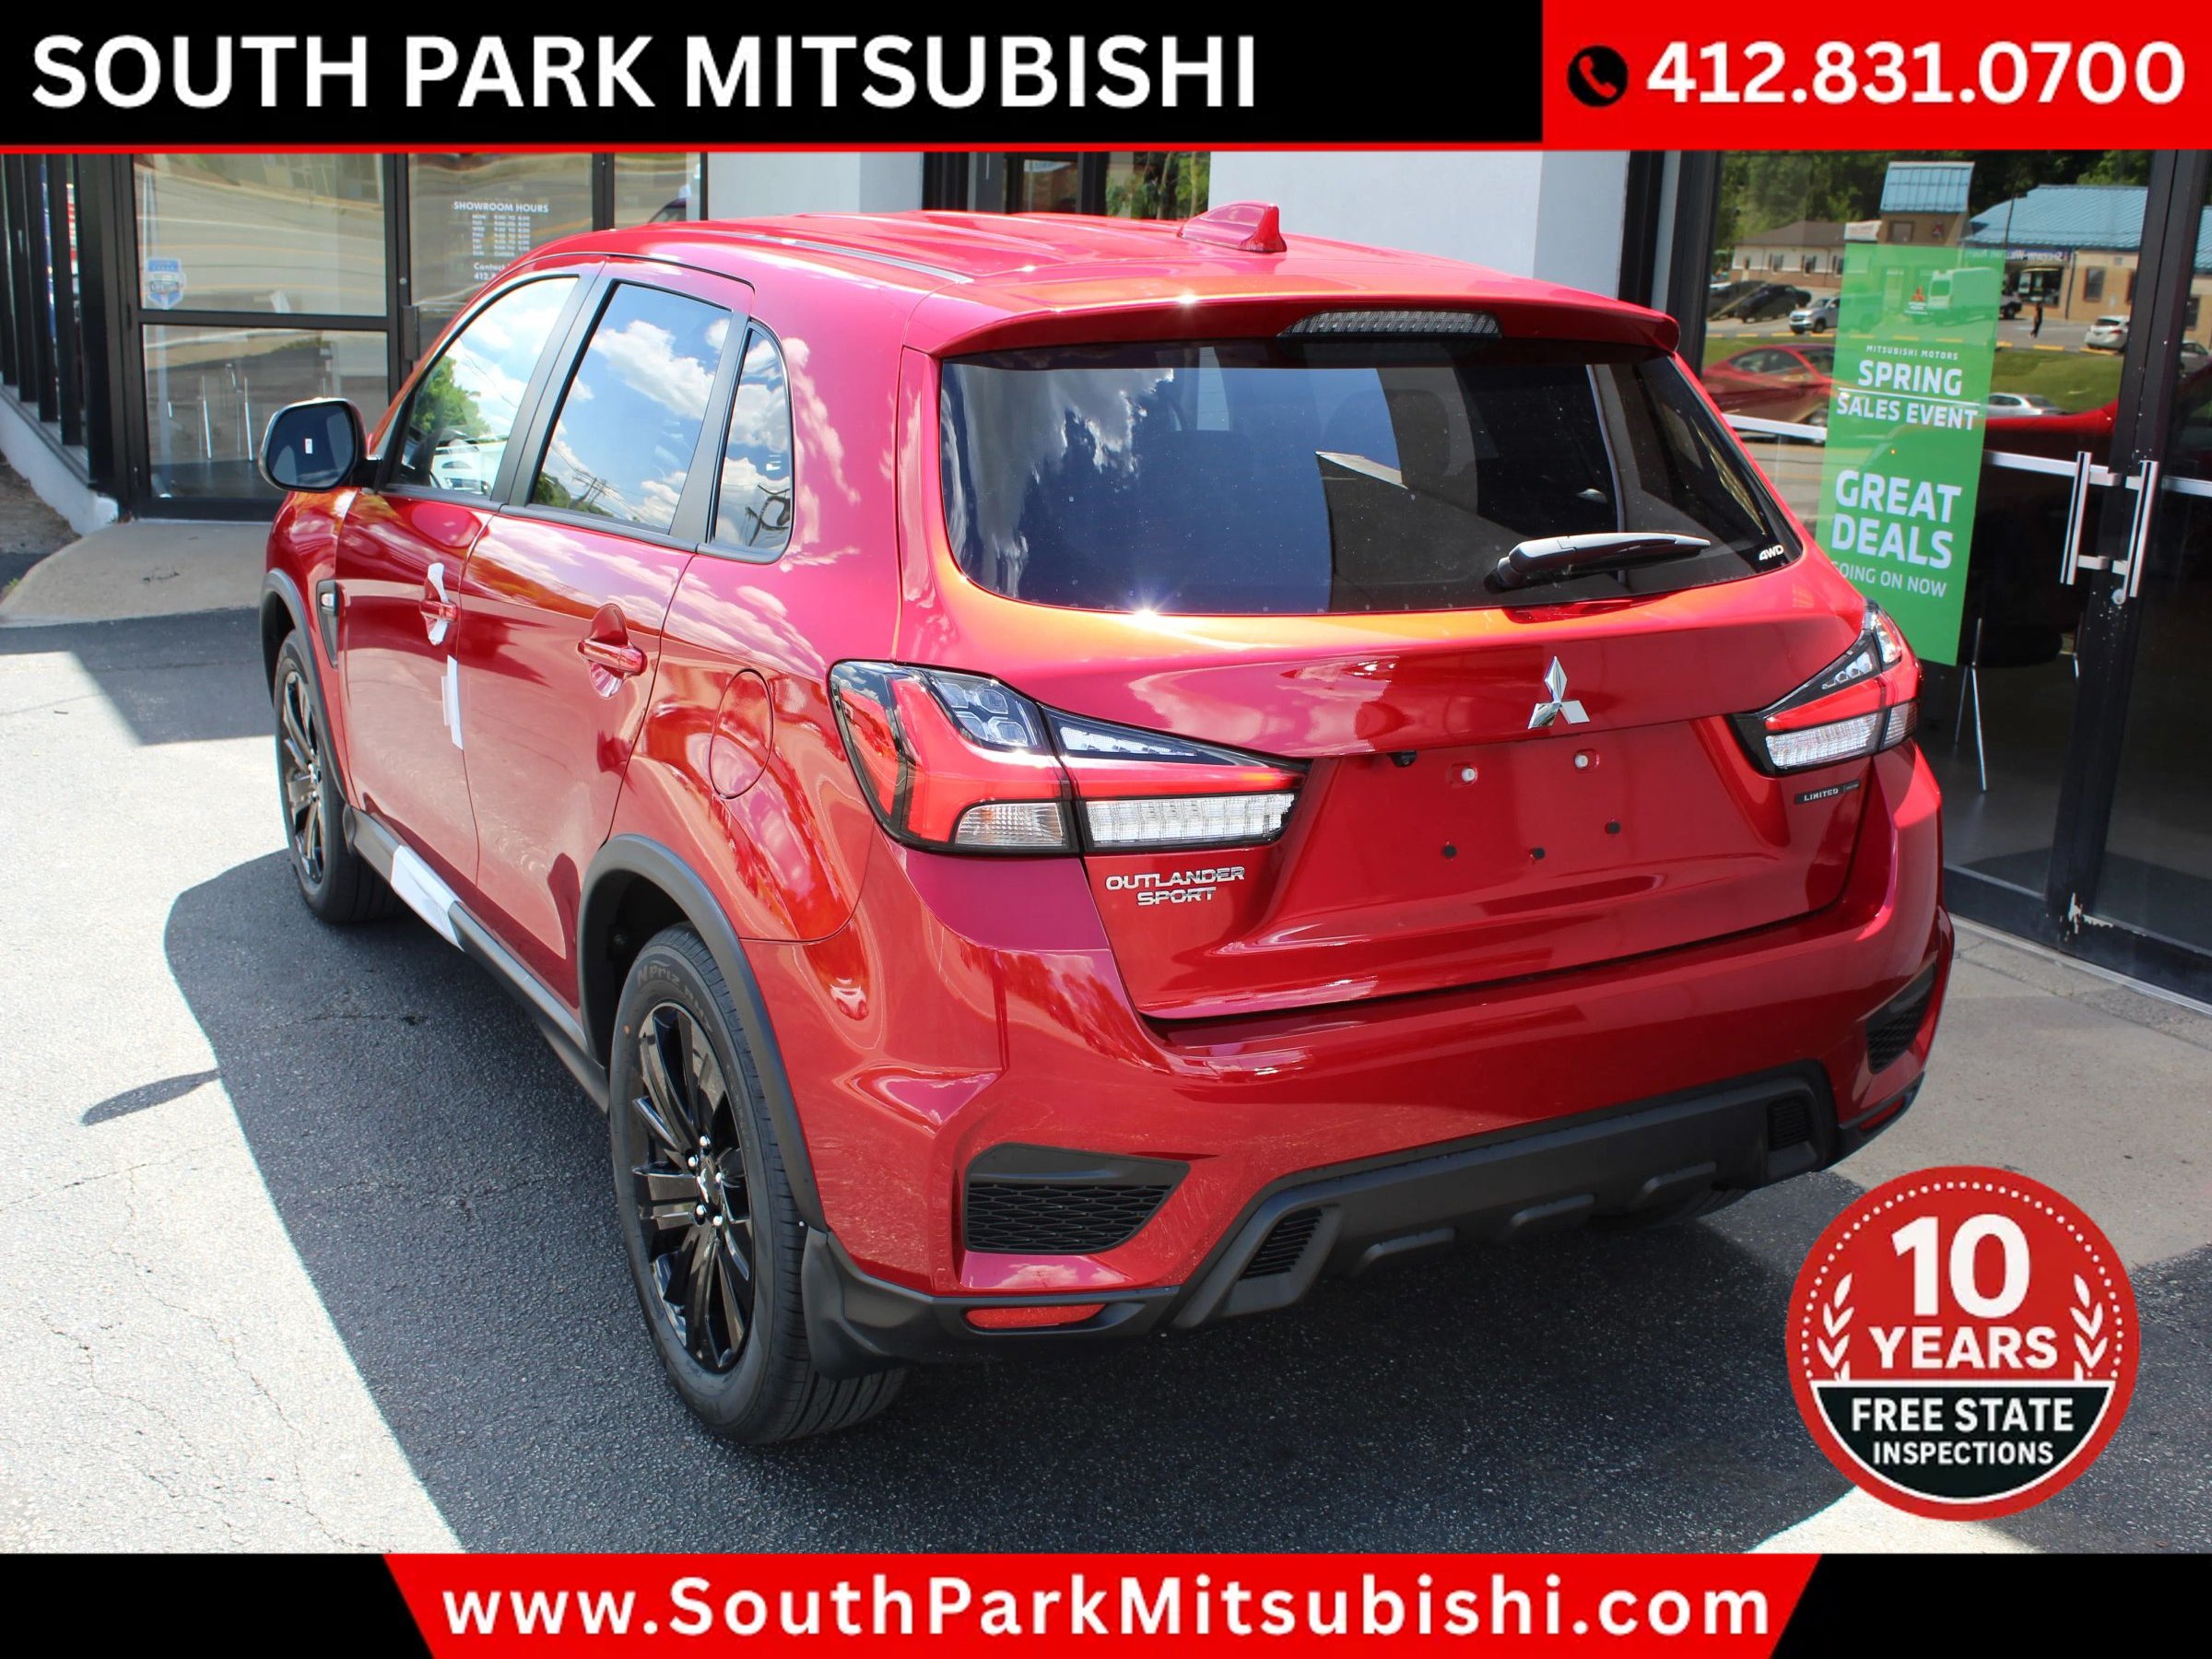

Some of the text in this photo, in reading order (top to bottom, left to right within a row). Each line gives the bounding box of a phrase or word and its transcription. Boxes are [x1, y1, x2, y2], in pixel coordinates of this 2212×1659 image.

[453, 201, 549, 213] SHOWROOM HOURS
[1865, 345, 1959, 360] MITSUBISHI MOTORS
[1857, 359, 1962, 396] SPRING
[1836, 393, 1979, 430] SALES EVENT
[1835, 469, 1962, 524] GREAT
[1759, 544, 1784, 561] 4WD
[1830, 512, 1954, 570] DEALS
[1880, 571, 1902, 590] ON
[1907, 575, 1947, 597] NOW
[1804, 788, 1839, 802] LIMITED
[1105, 866, 1246, 891] OUTLANDER
[1136, 887, 1218, 907] SPORT
